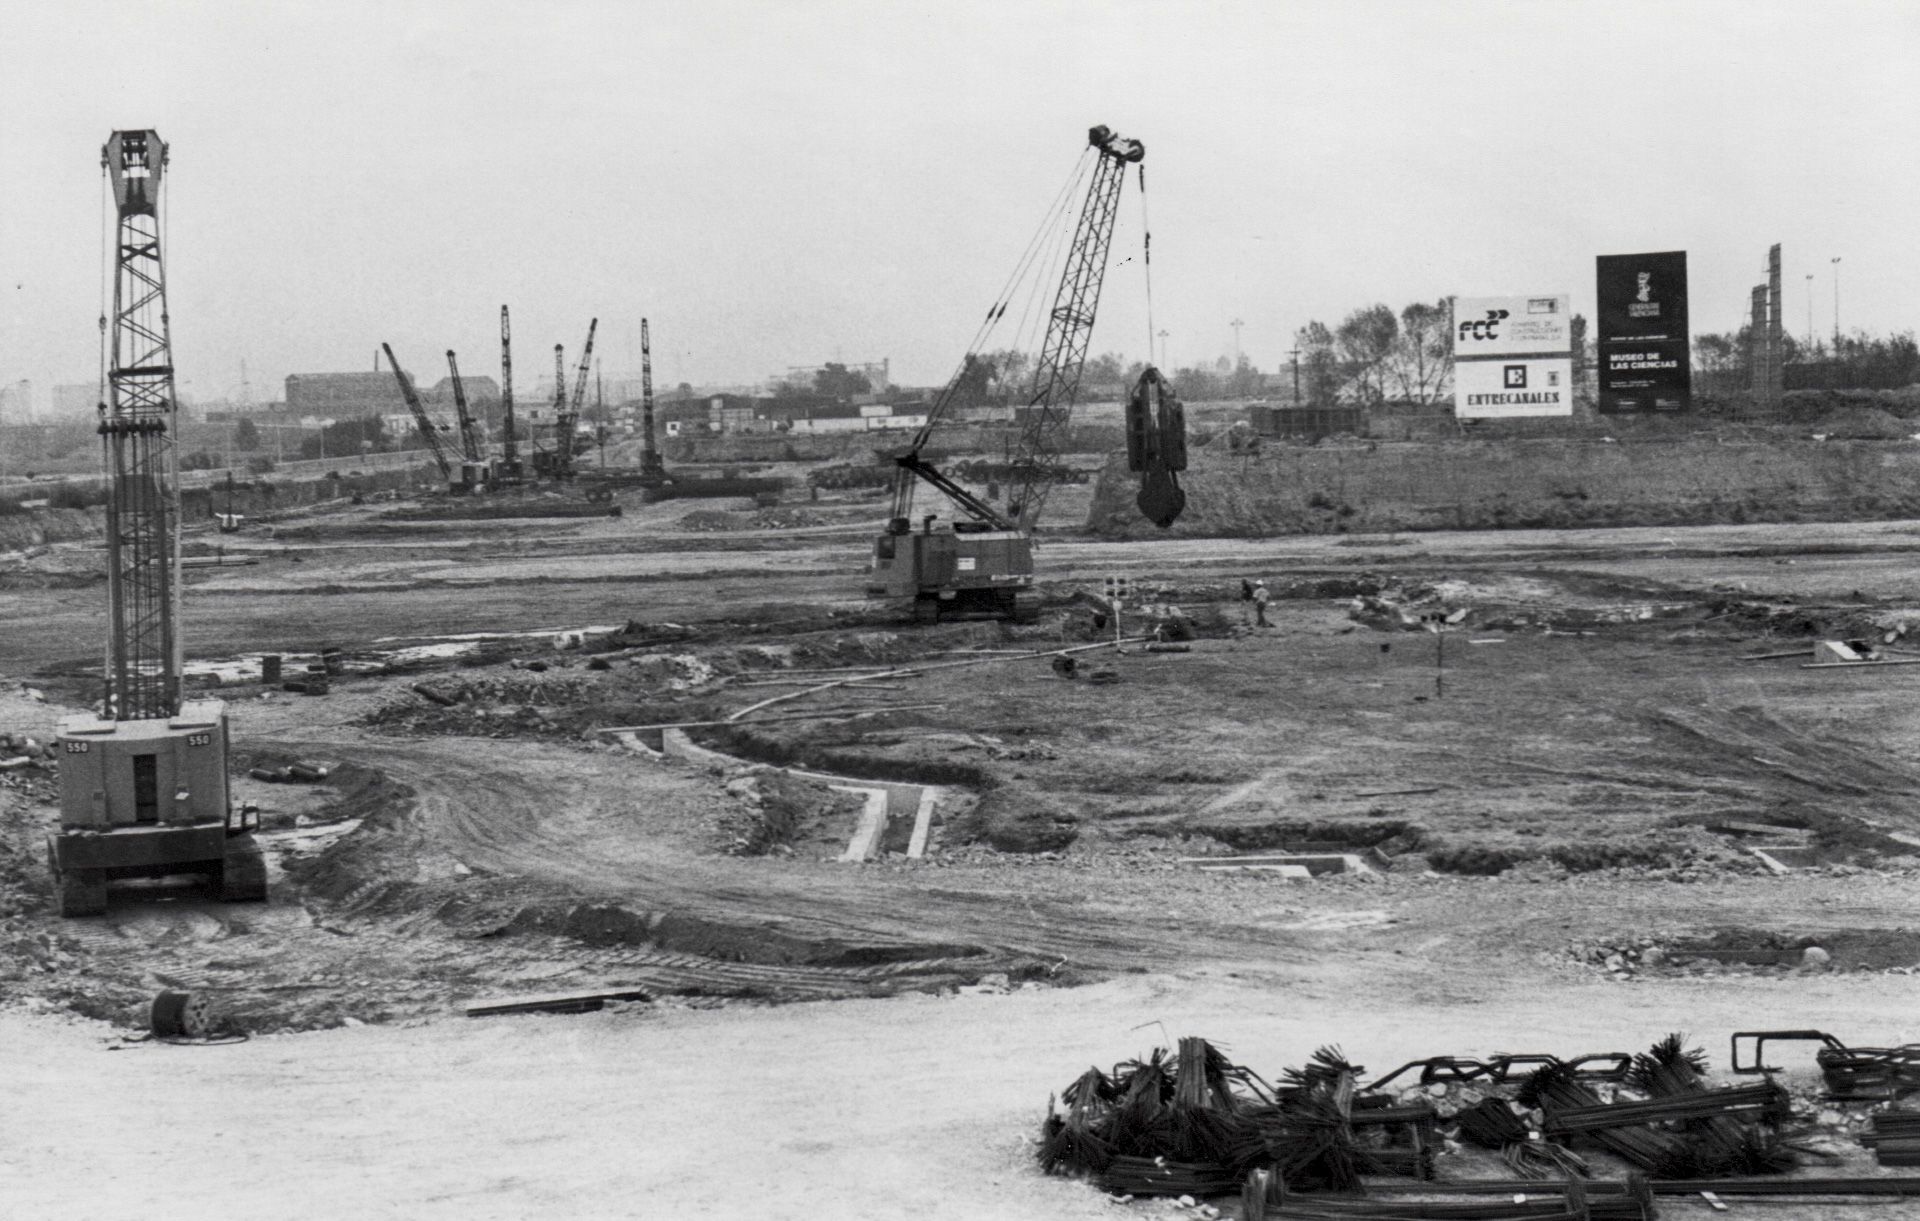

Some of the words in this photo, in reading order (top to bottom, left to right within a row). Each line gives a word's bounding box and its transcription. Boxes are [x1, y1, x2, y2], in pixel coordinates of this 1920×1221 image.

[1459, 320, 1499, 341] FCC
[1610, 353, 1644, 362] MUSEO
[1646, 352, 1660, 360] DE
[1610, 362, 1629, 370] LAS
[1631, 360, 1678, 369] CIENCIAS
[189, 735, 210, 746] 550
[67, 742, 88, 752] 550
